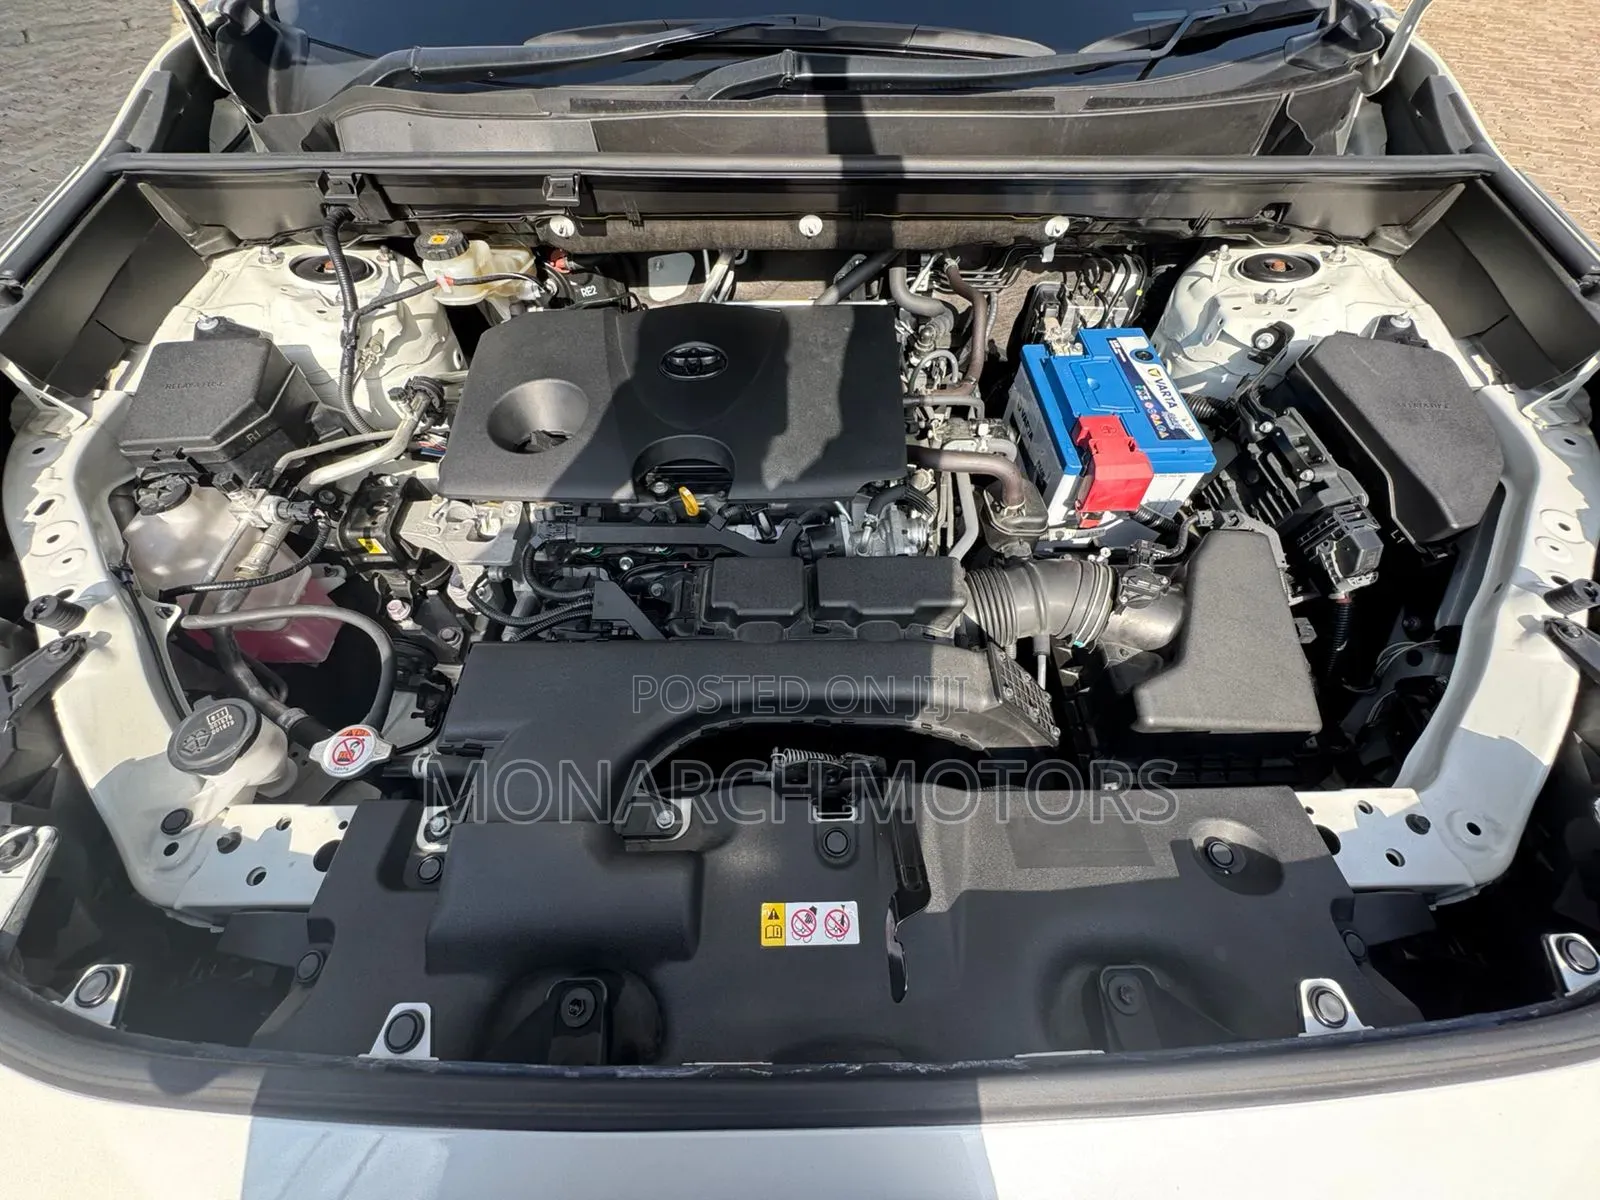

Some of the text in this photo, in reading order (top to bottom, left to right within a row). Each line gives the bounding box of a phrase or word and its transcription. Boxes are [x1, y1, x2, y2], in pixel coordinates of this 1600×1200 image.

[1154, 378, 1178, 409] VARTA
[246, 430, 262, 443] R1
[1390, 529, 1406, 544] L1
